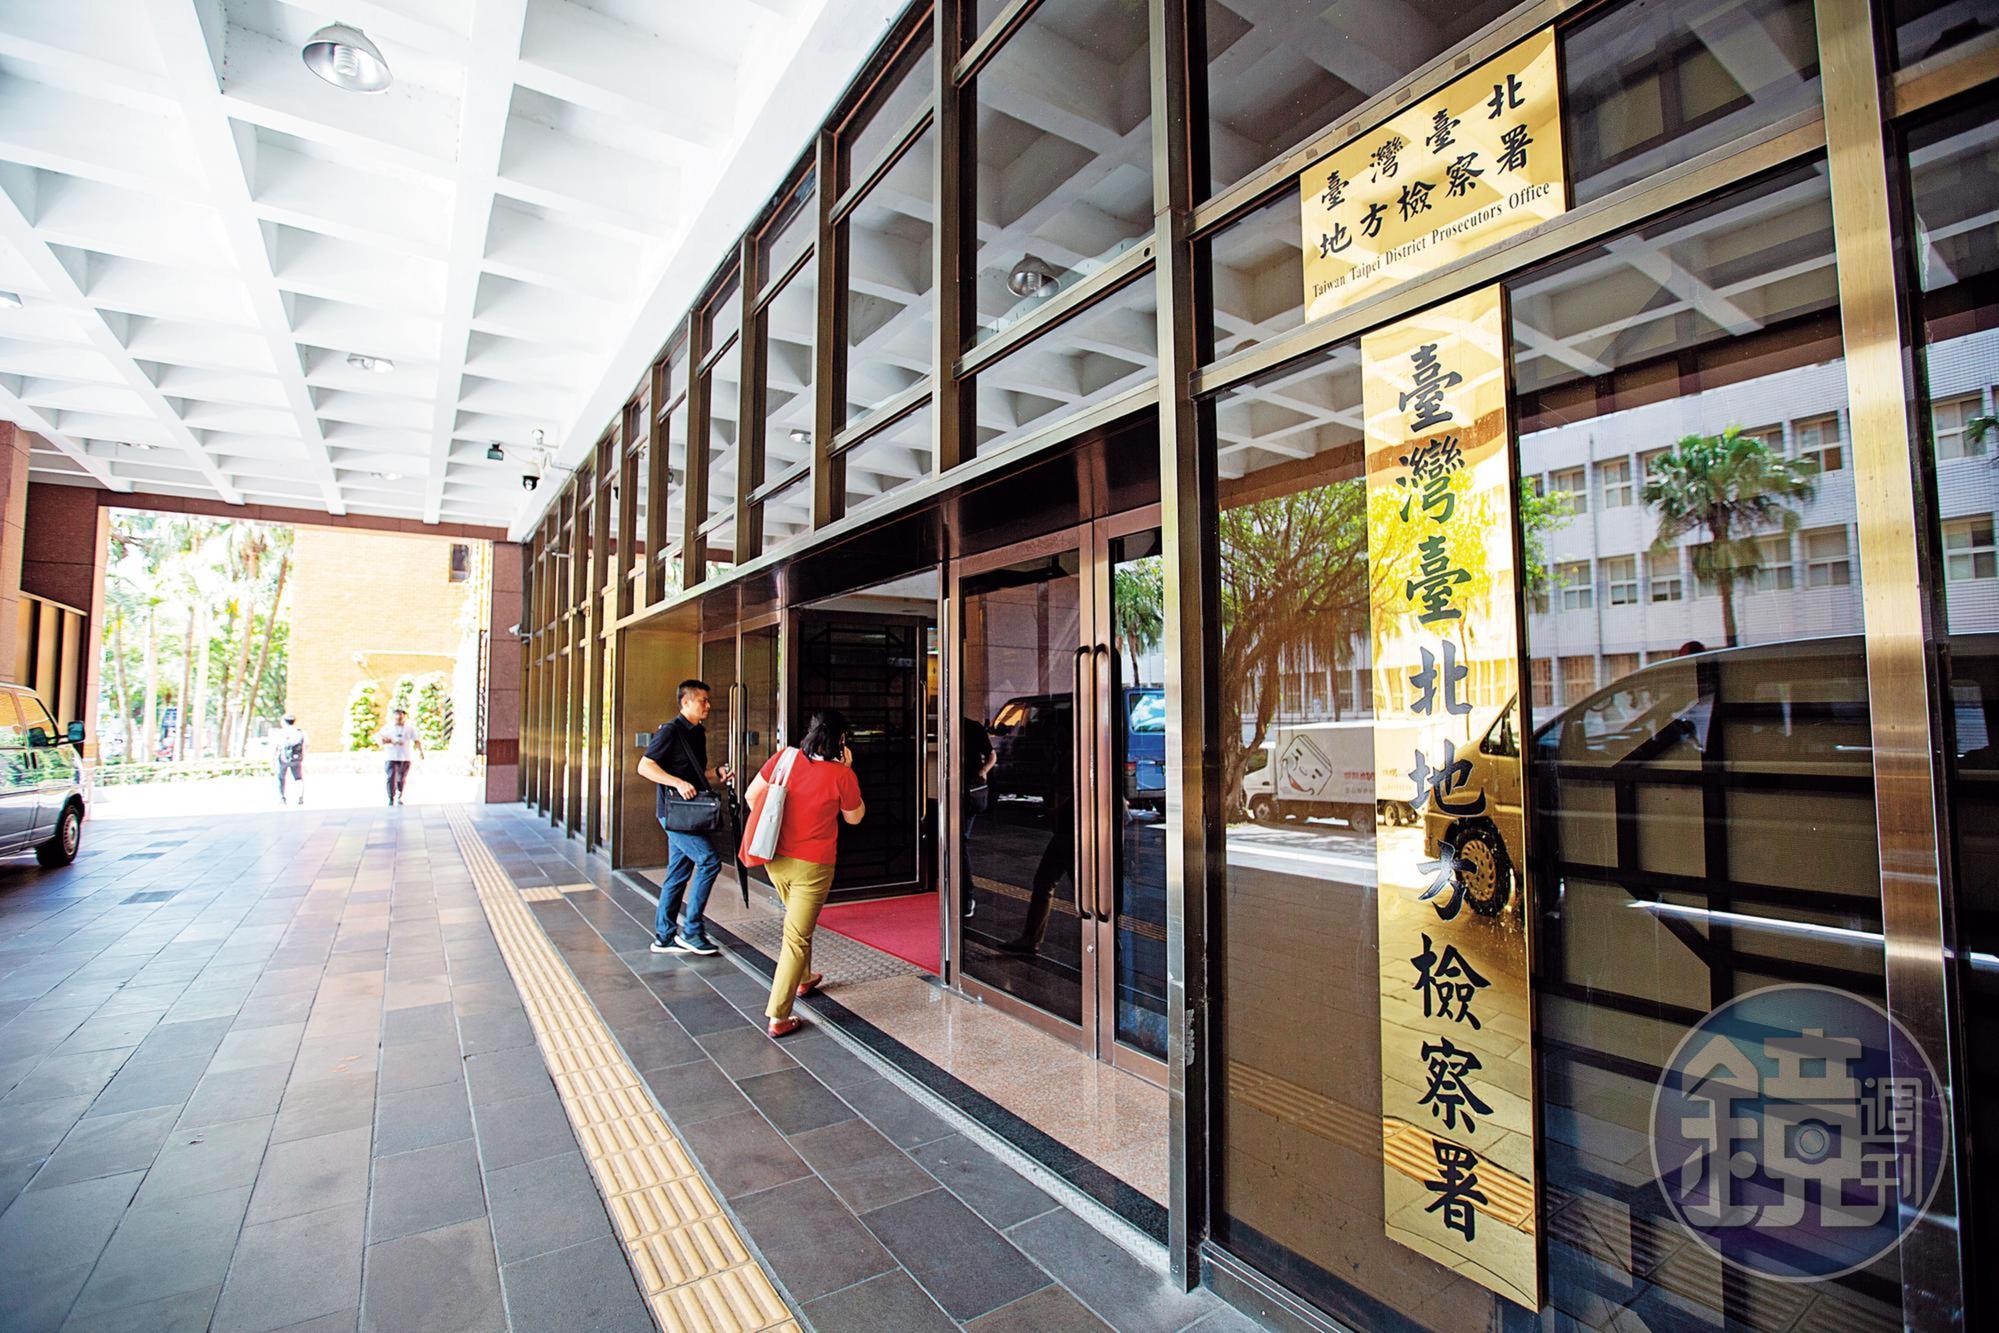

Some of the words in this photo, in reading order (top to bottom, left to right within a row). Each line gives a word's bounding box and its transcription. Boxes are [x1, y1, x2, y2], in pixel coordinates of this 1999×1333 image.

[1319, 123, 1534, 259] 地方檢察署
[1321, 74, 1526, 211] 臺灣臺北
[1312, 275, 1346, 298] Taiwan
[1349, 258, 1381, 281] Taipei
[1385, 237, 1427, 266] District
[1432, 203, 1503, 247] Prosecutors
[1508, 182, 1551, 210] Office
[1396, 343, 1494, 1243] 臺灣臺北地方檢察署
